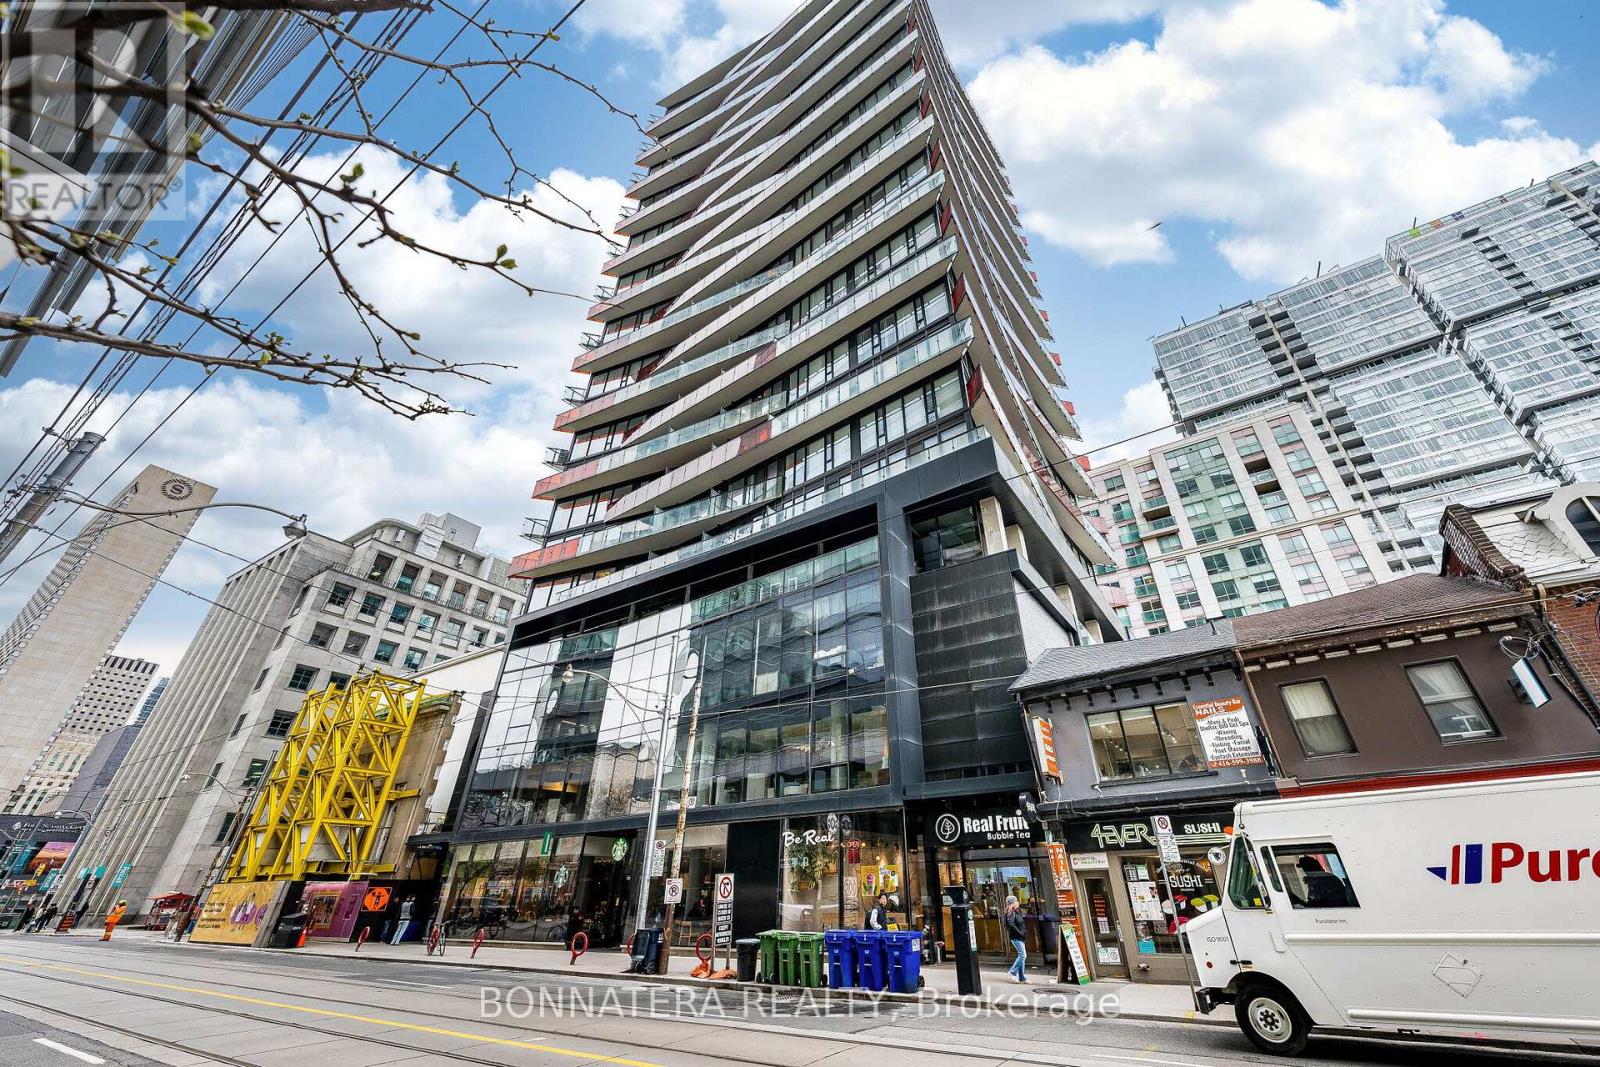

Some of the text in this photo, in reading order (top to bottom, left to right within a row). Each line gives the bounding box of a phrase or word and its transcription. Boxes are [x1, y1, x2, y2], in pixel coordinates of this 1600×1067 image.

[1195, 705, 1226, 715] NAILS
[963, 815, 993, 833] Real
[1184, 822, 1221, 834] SUSHI
[782, 829, 835, 847] Be Real
[987, 830, 1031, 840] Bubble Tea
[1491, 842, 1600, 883] Pur
[1169, 875, 1203, 888] SUSHI
